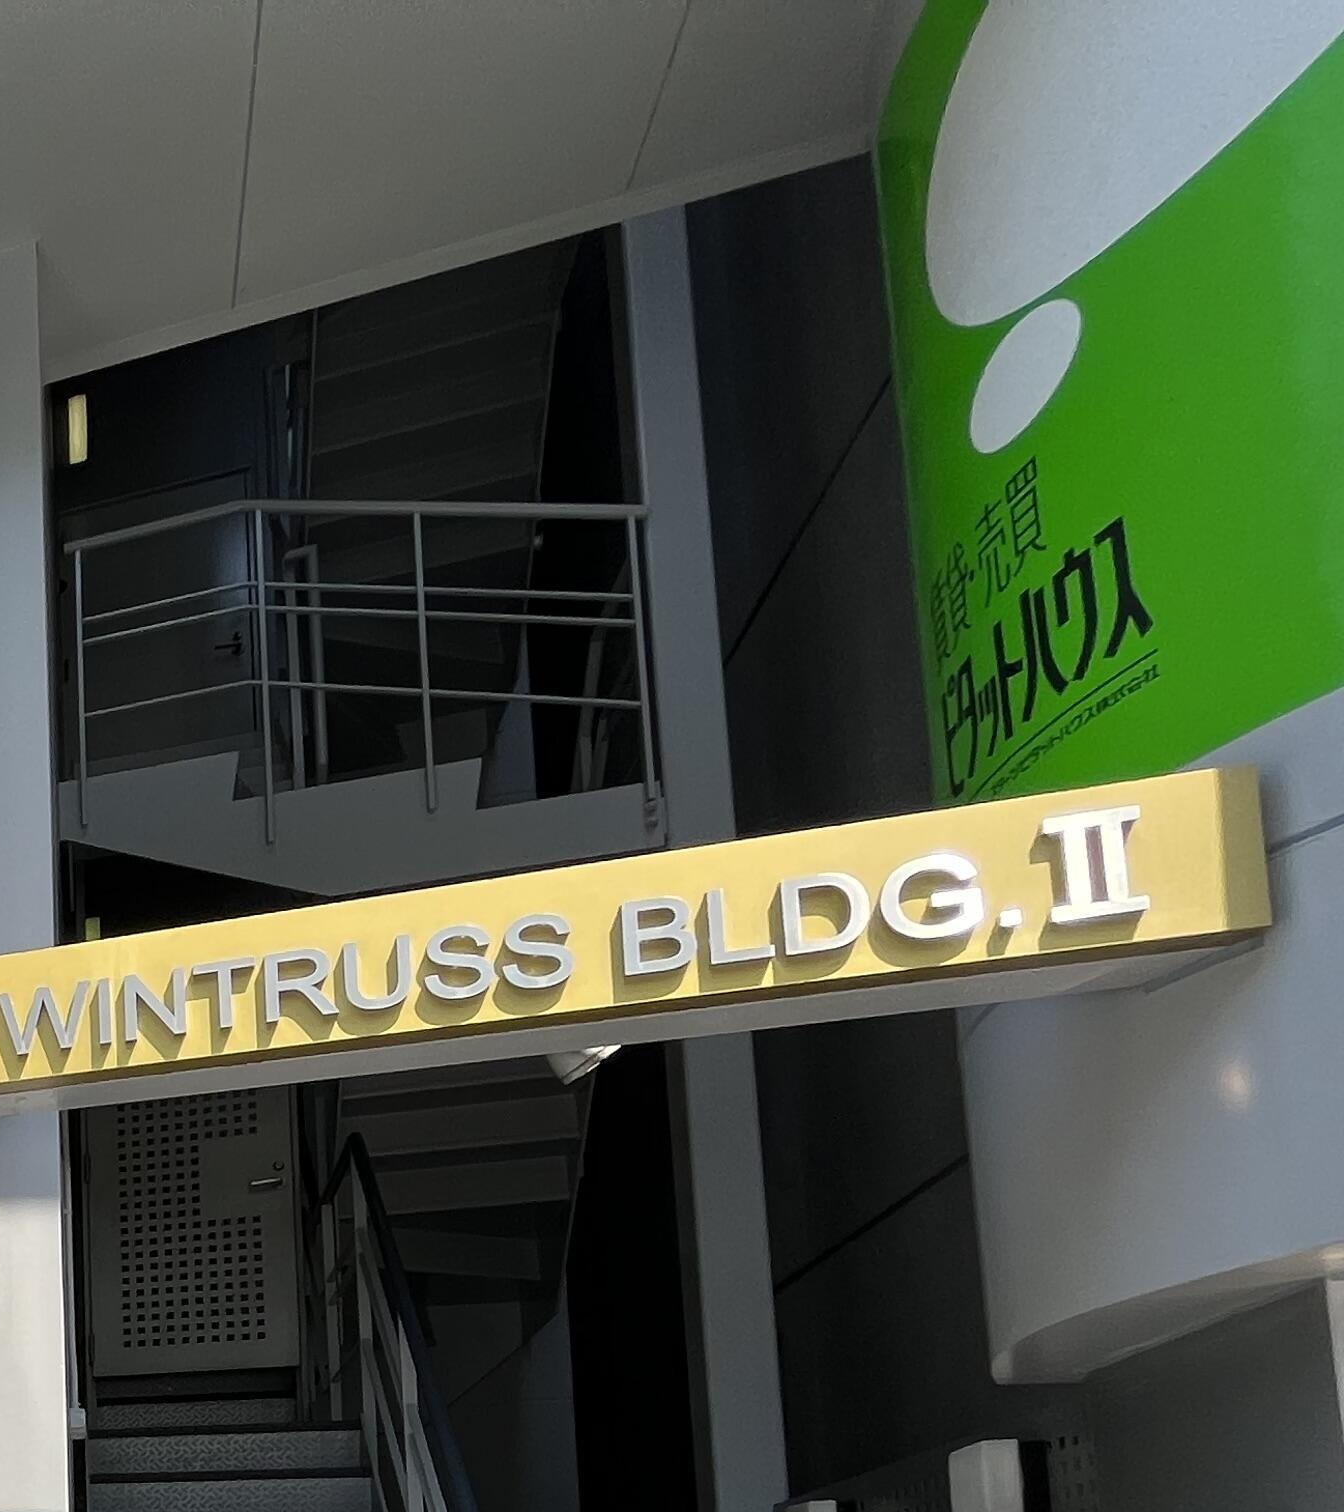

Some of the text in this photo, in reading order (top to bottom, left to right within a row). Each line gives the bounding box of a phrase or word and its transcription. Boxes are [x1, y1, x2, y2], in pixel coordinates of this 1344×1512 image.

[942, 516, 1153, 798] ピタットハウス
